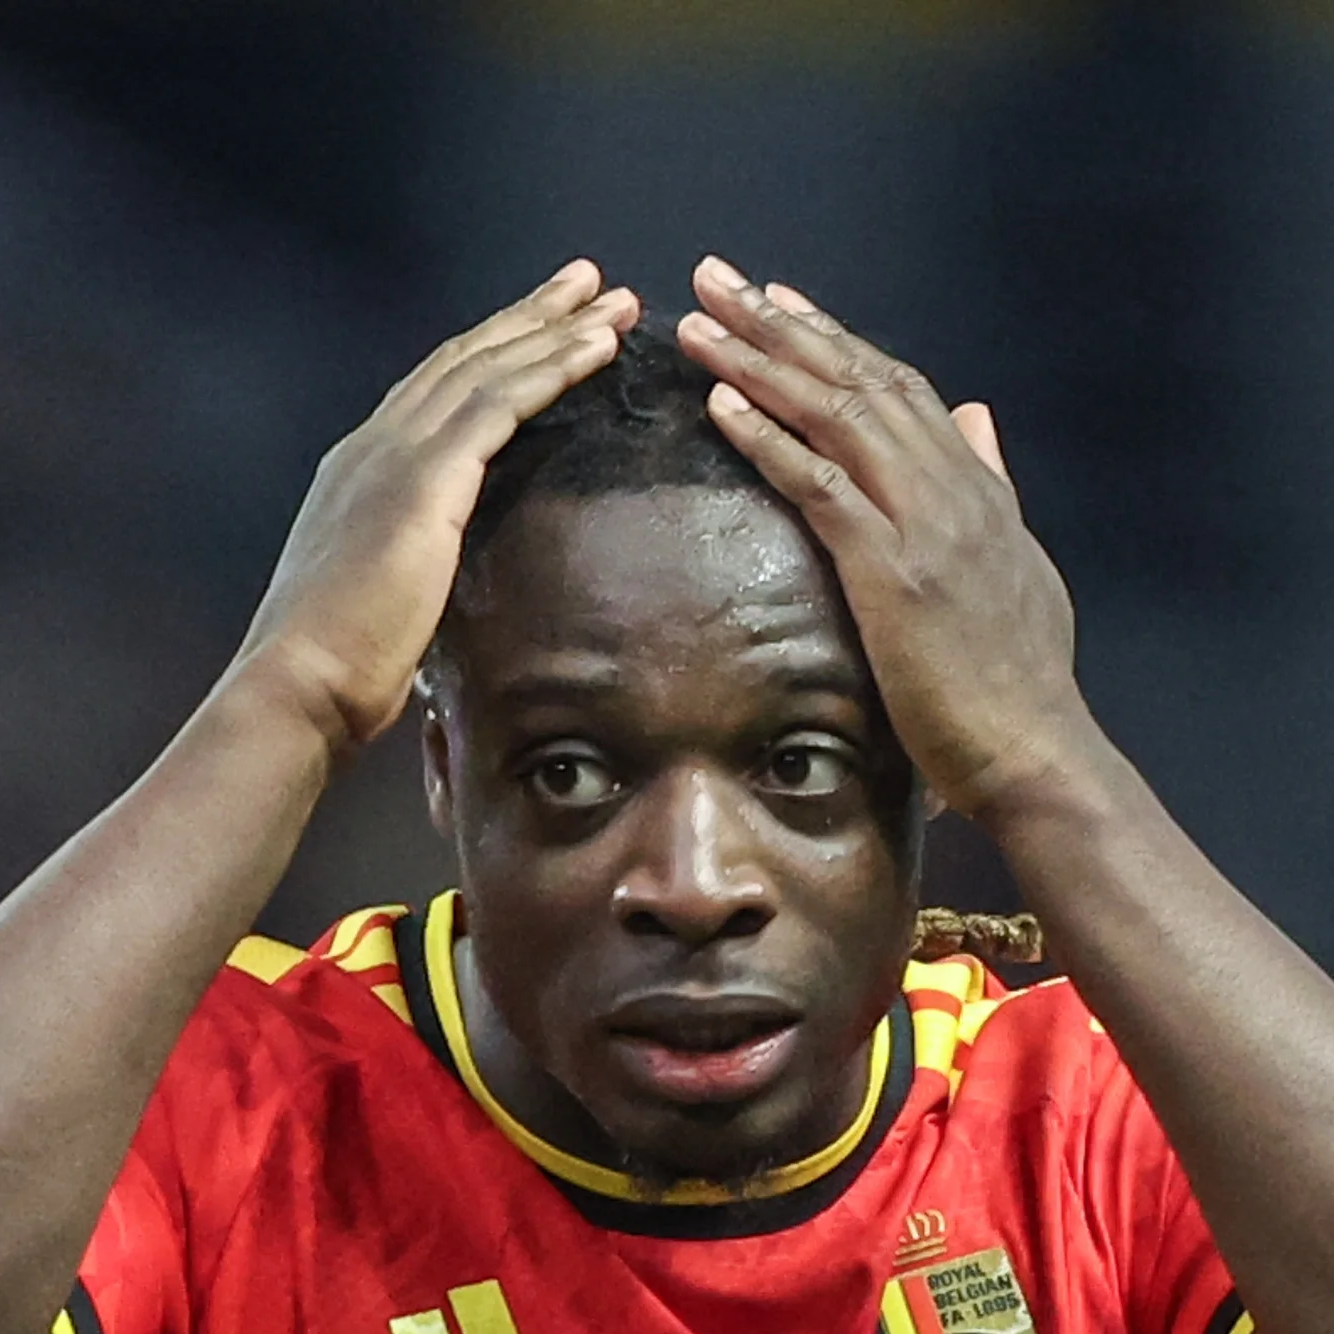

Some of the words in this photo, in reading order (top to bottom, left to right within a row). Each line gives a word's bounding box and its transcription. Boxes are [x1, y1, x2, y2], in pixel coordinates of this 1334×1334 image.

[927, 1262, 985, 1289] ROYAL
[933, 1273, 1012, 1309] BELGIAN
[940, 1309, 965, 1328] FA
